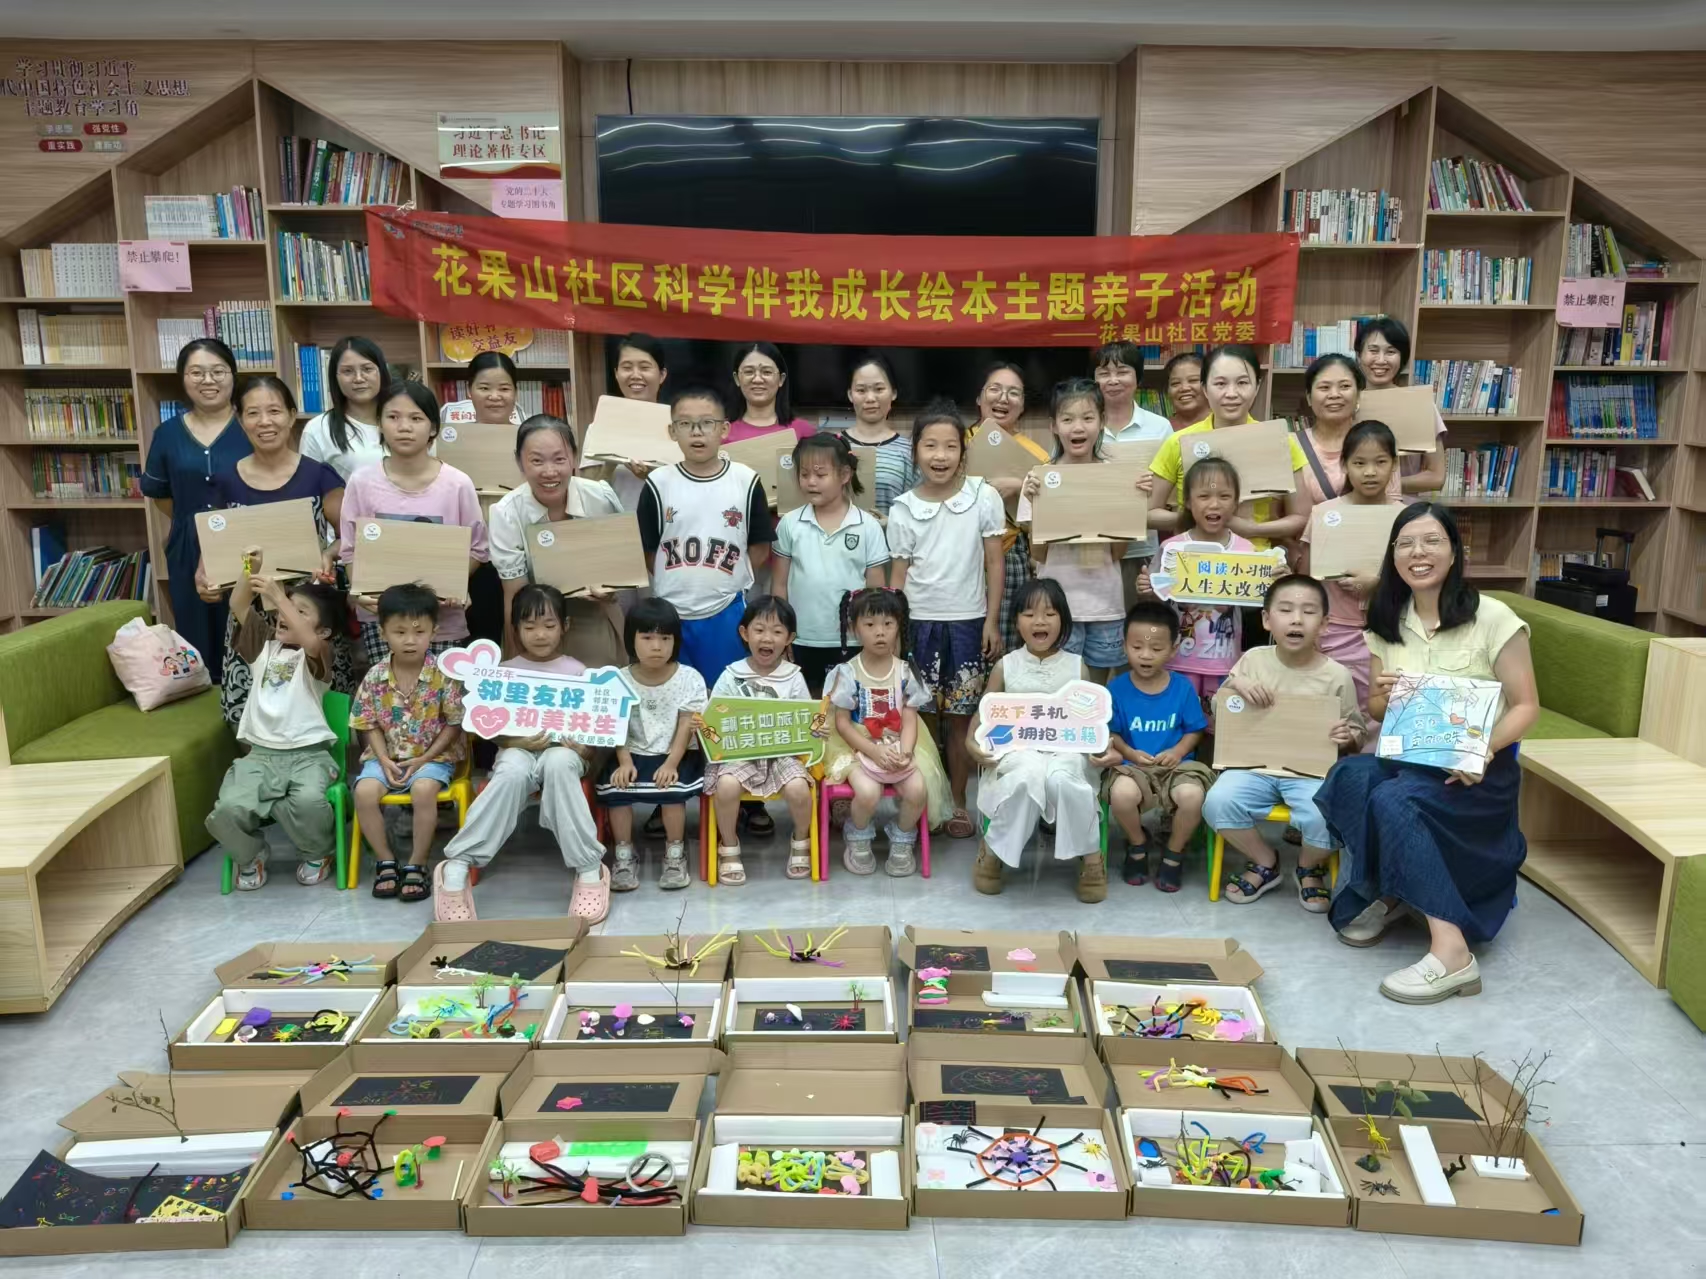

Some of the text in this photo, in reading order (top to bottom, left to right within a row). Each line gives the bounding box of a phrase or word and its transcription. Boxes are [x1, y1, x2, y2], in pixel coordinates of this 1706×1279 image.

[91, 124, 121, 134] 强党性
[452, 143, 547, 159] 理论著作专区
[505, 186, 550, 197] 党的二十大
[500, 199, 556, 209] 专题学习图书角
[430, 243, 1259, 323] 花果山社区科学伴我成长绘本主题亲子活动
[472, 332, 517, 353] 交益友
[1198, 561, 1272, 578] 阅读小习惯
[473, 667, 514, 679] 2025年
[477, 679, 585, 709] 邻里友好
[514, 707, 617, 735] 和美共生
[720, 708, 811, 732] 翻书如旅行
[990, 705, 1068, 720] 放下手机
[721, 728, 809, 750] 心灵在路上
[1018, 726, 1097, 745] 拥抱书籍
